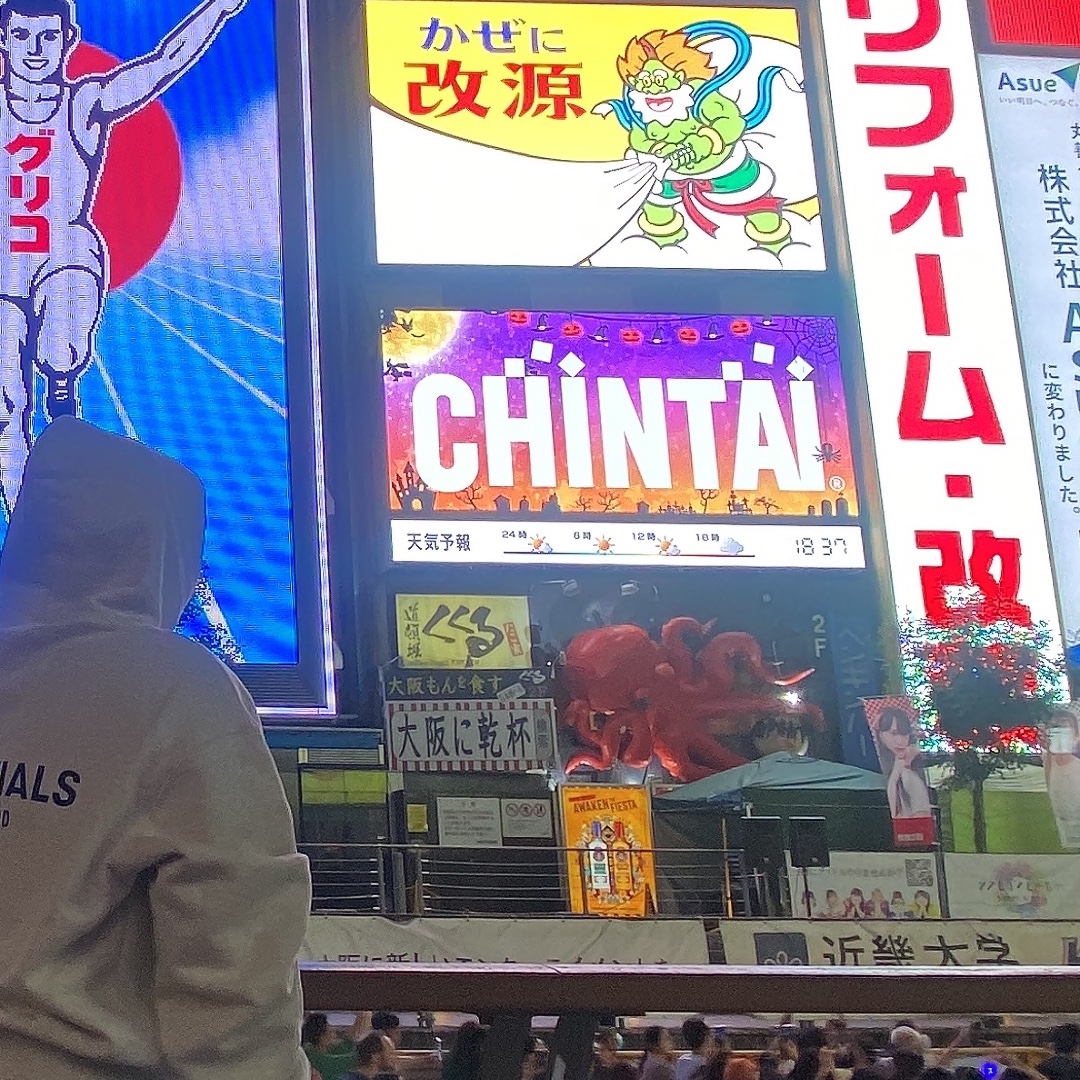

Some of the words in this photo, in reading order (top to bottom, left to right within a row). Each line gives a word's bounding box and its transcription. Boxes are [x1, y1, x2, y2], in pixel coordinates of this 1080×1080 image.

[419, 17, 567, 54] かぜに
[404, 60, 598, 120] 改源
[3, 128, 56, 254] グリコ
[412, 352, 827, 493] CHINTAI
[406, 531, 472, 552] 天気予報
[398, 712, 532, 758] 大阪に乾杯
